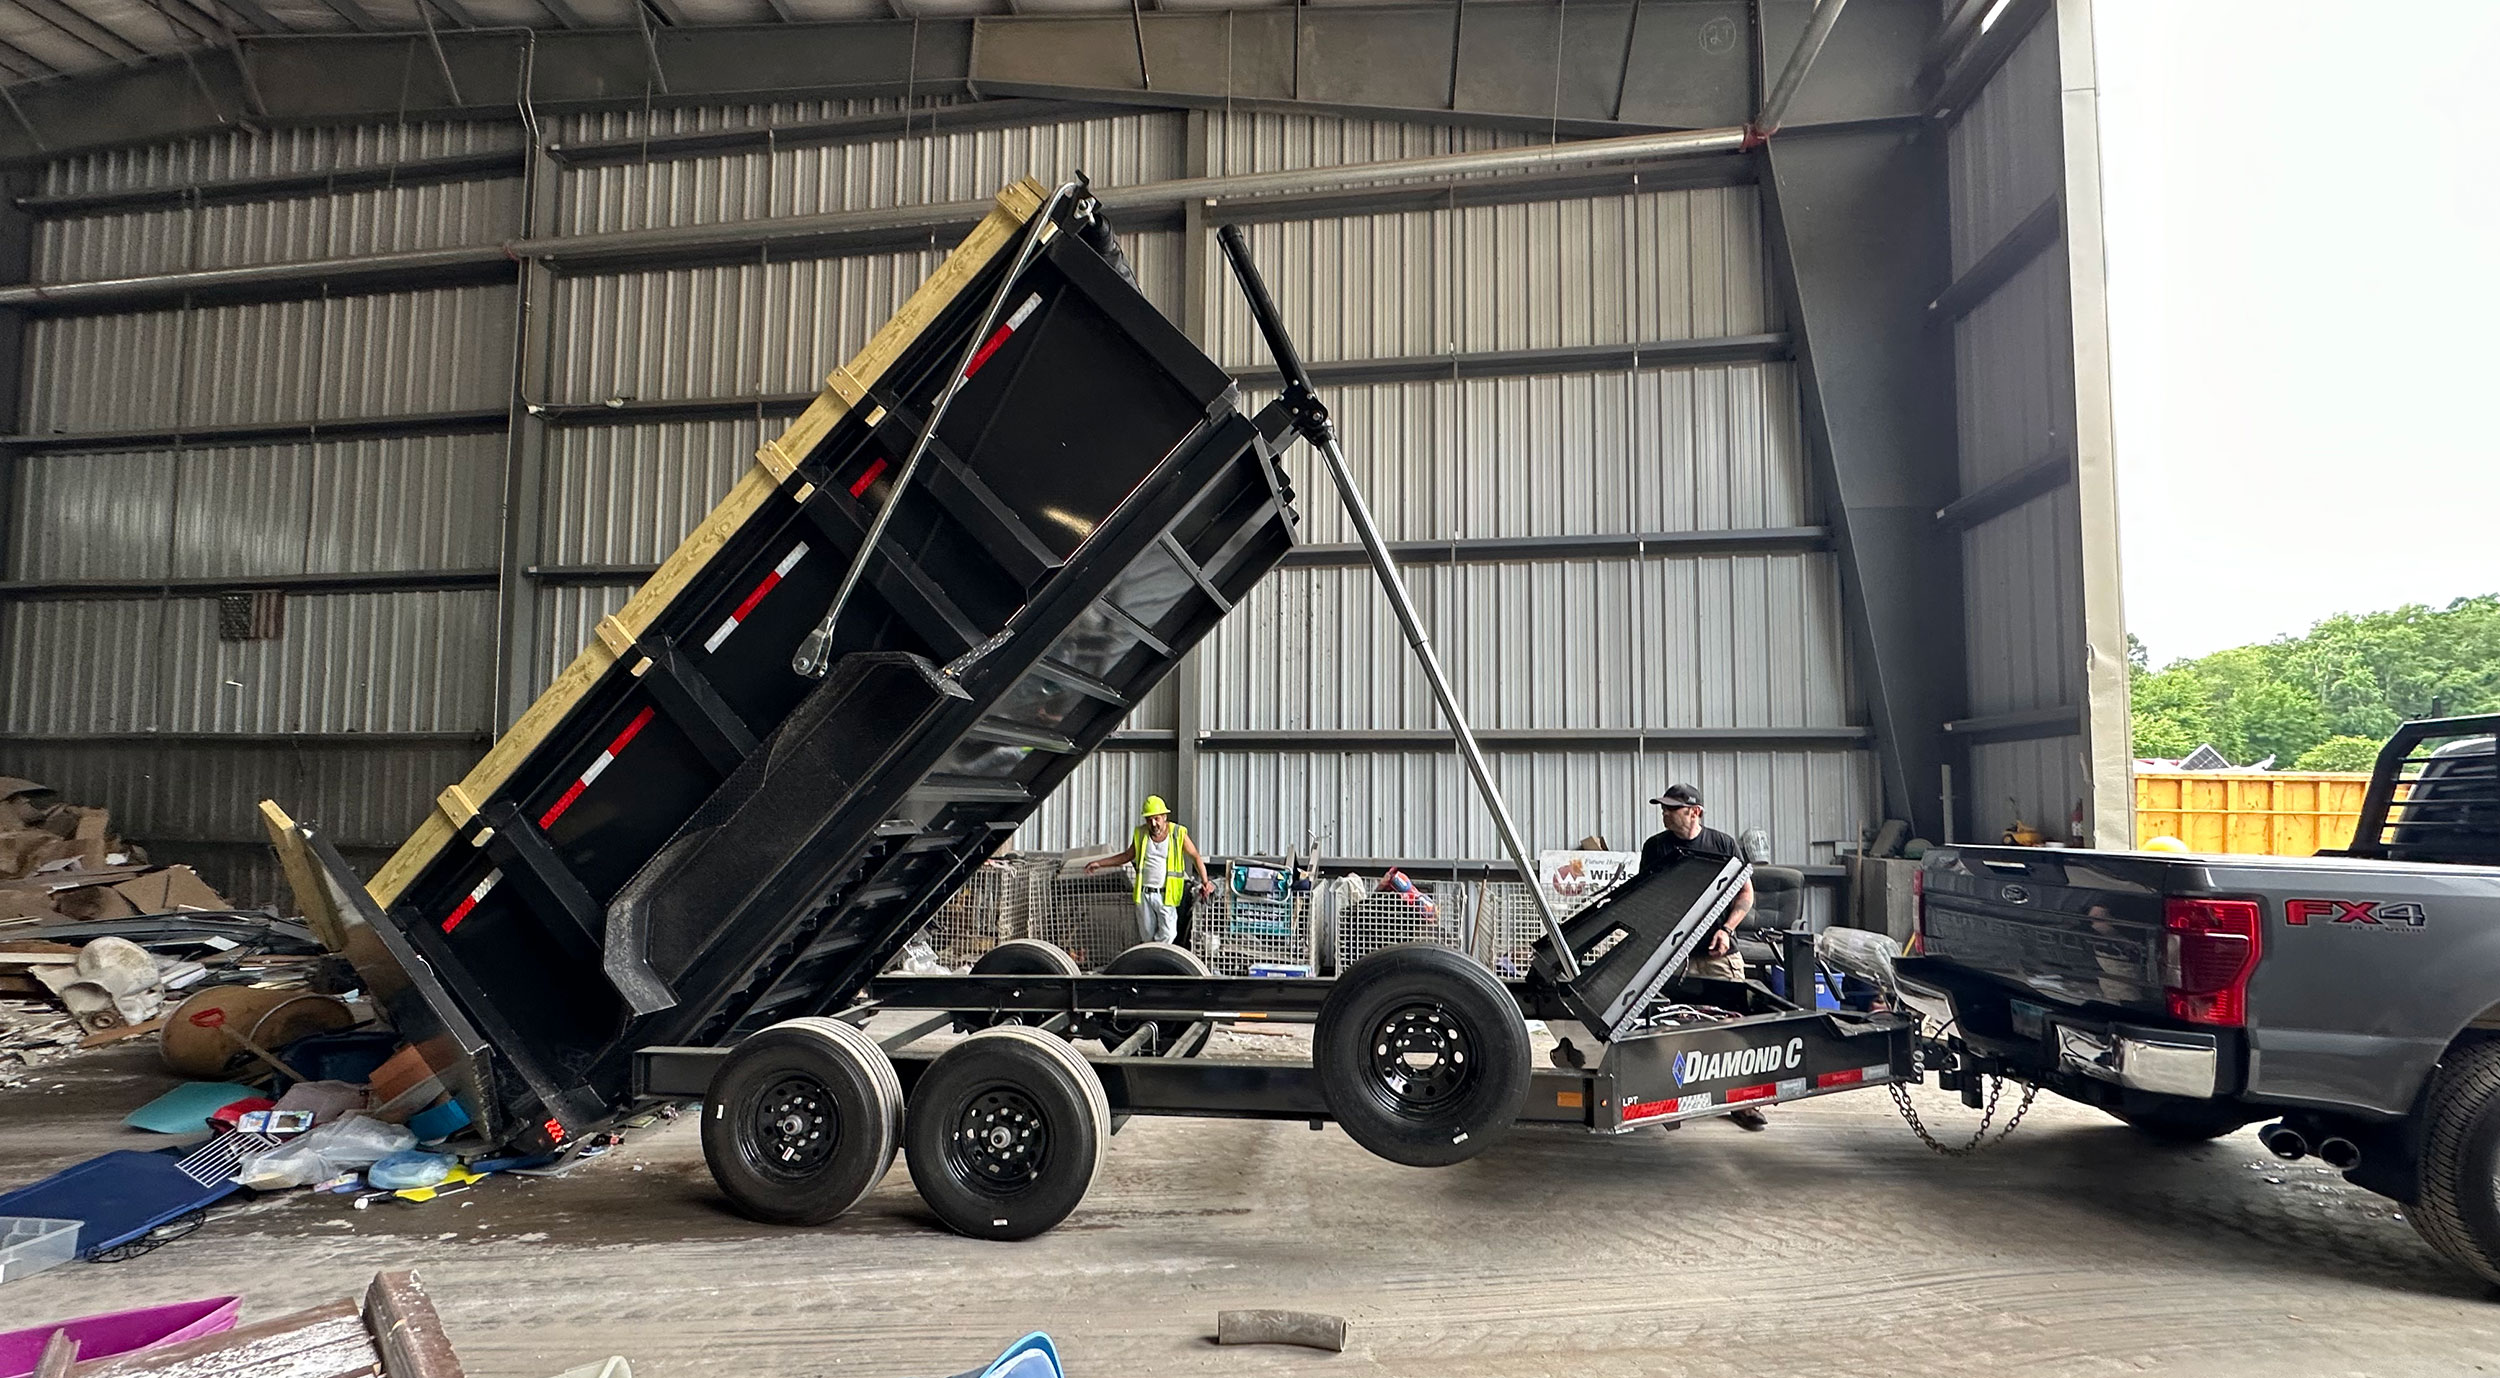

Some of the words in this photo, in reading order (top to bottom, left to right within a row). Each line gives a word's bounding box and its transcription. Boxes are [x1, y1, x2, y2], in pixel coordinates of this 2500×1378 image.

[2284, 897, 2426, 927] FX4
[1683, 1045, 1782, 1084] DIAMOND
[1785, 1037, 1803, 1069] C
[1622, 1095, 1639, 1107] LPT
